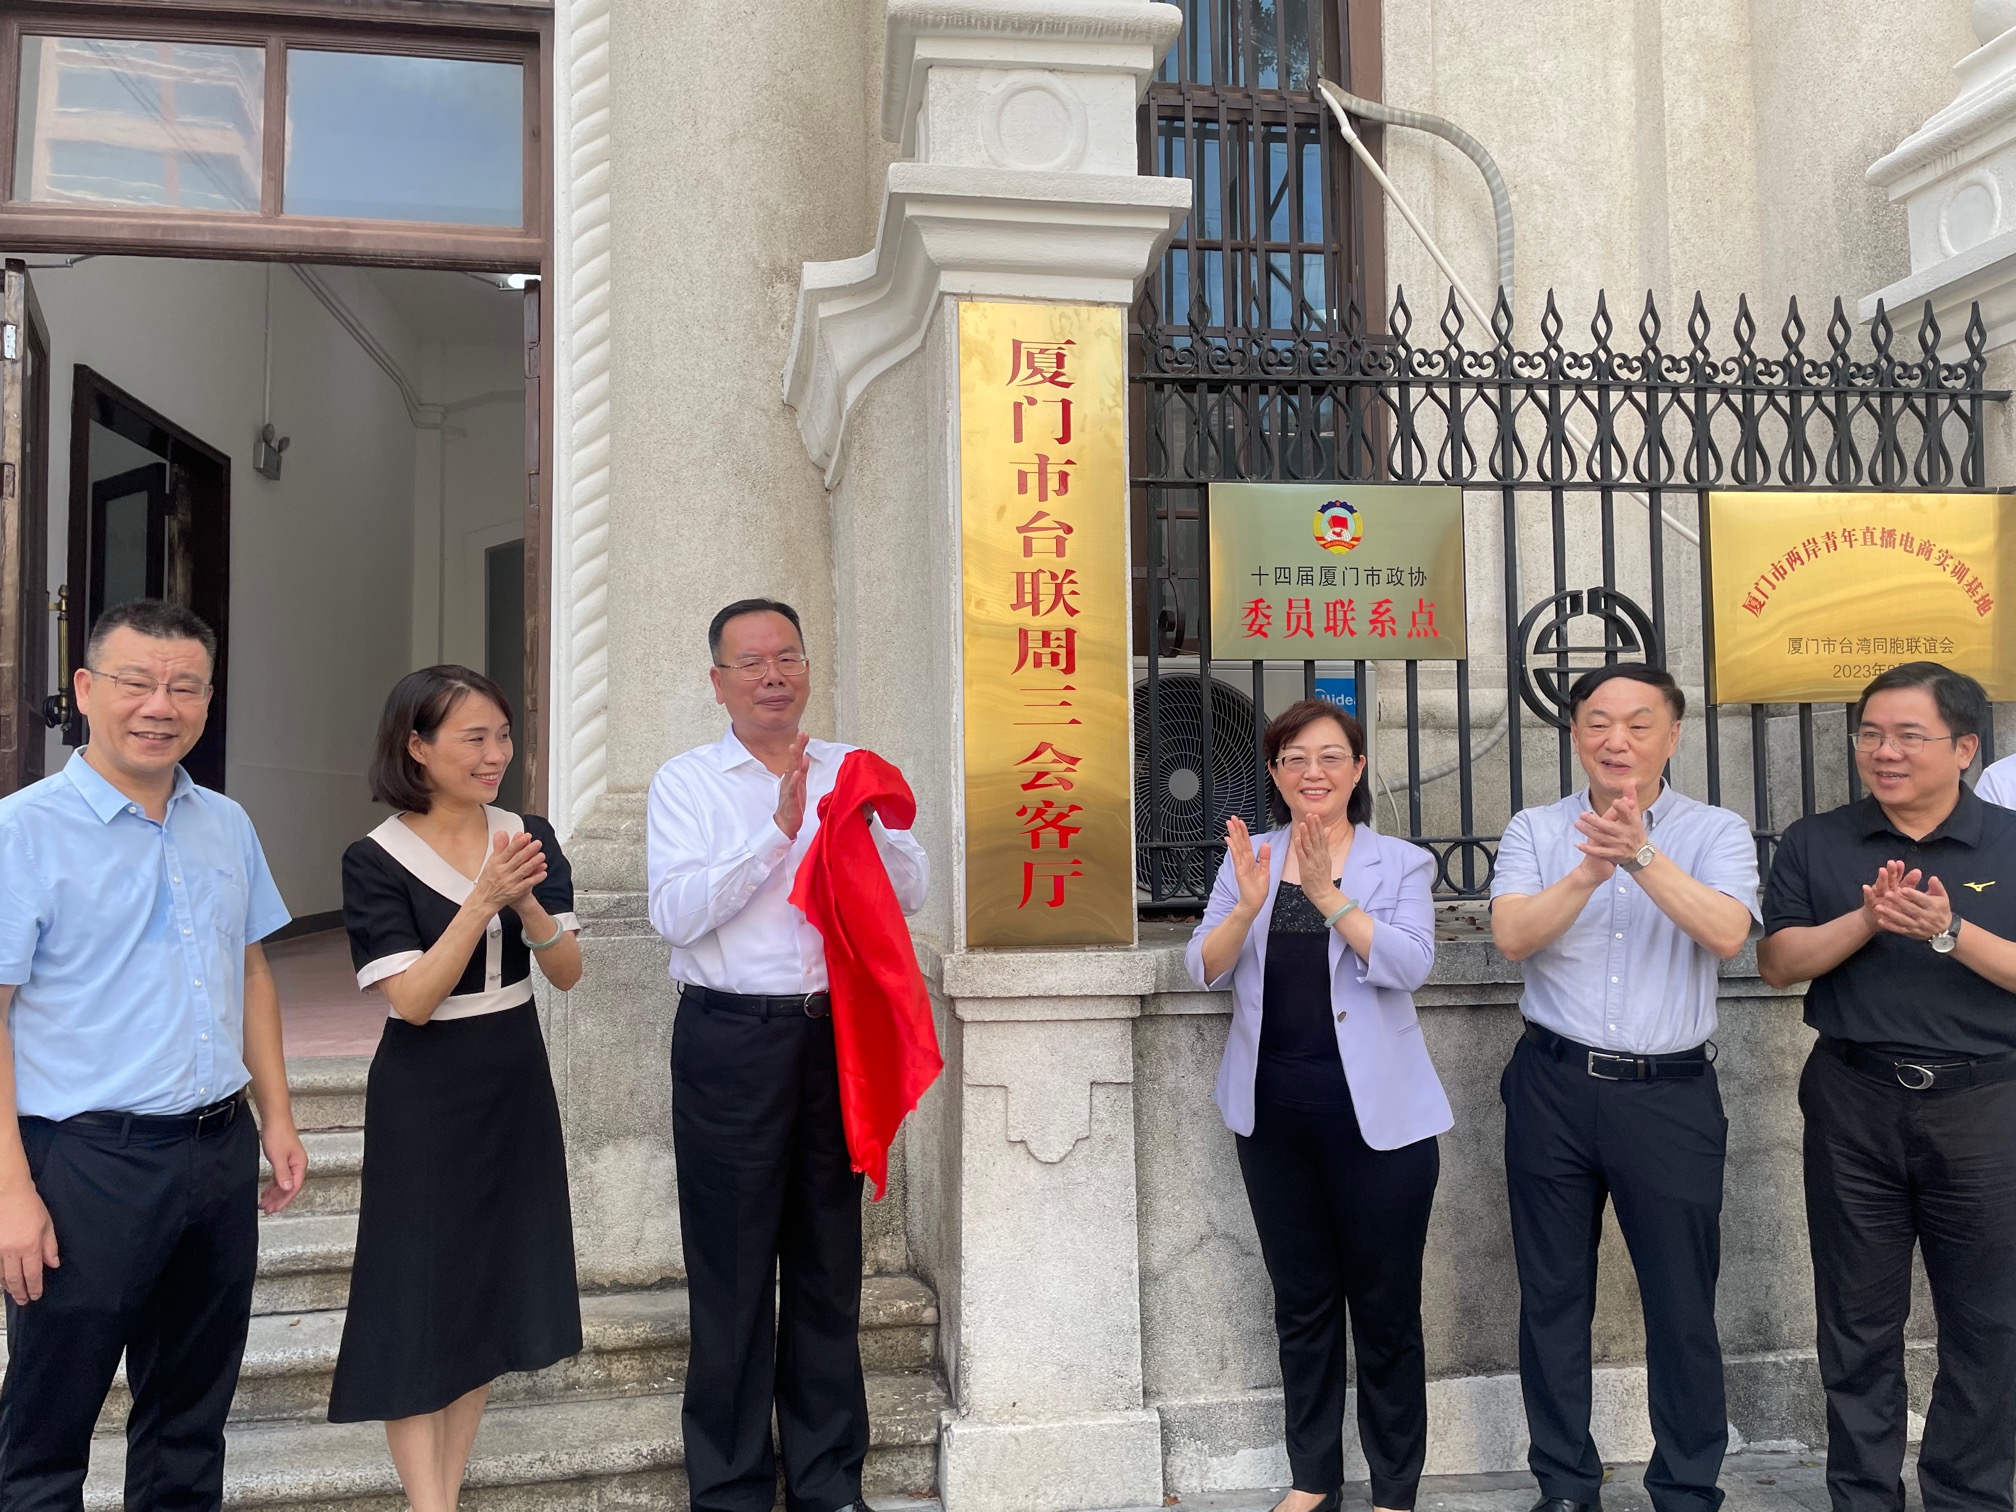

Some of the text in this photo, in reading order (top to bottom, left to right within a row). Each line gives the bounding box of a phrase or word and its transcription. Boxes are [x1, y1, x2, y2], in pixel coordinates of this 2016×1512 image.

[1251, 565, 1428, 587] 十四届厦门市政协
[1742, 526, 1994, 617] 厦门市两岸青年直播电商实训基地
[1006, 338, 1084, 910] 厦门市台联周三会客厅
[1241, 597, 1439, 639] 委员联系点
[1787, 636, 1955, 655] 厦门市台湾同胞联谊会
